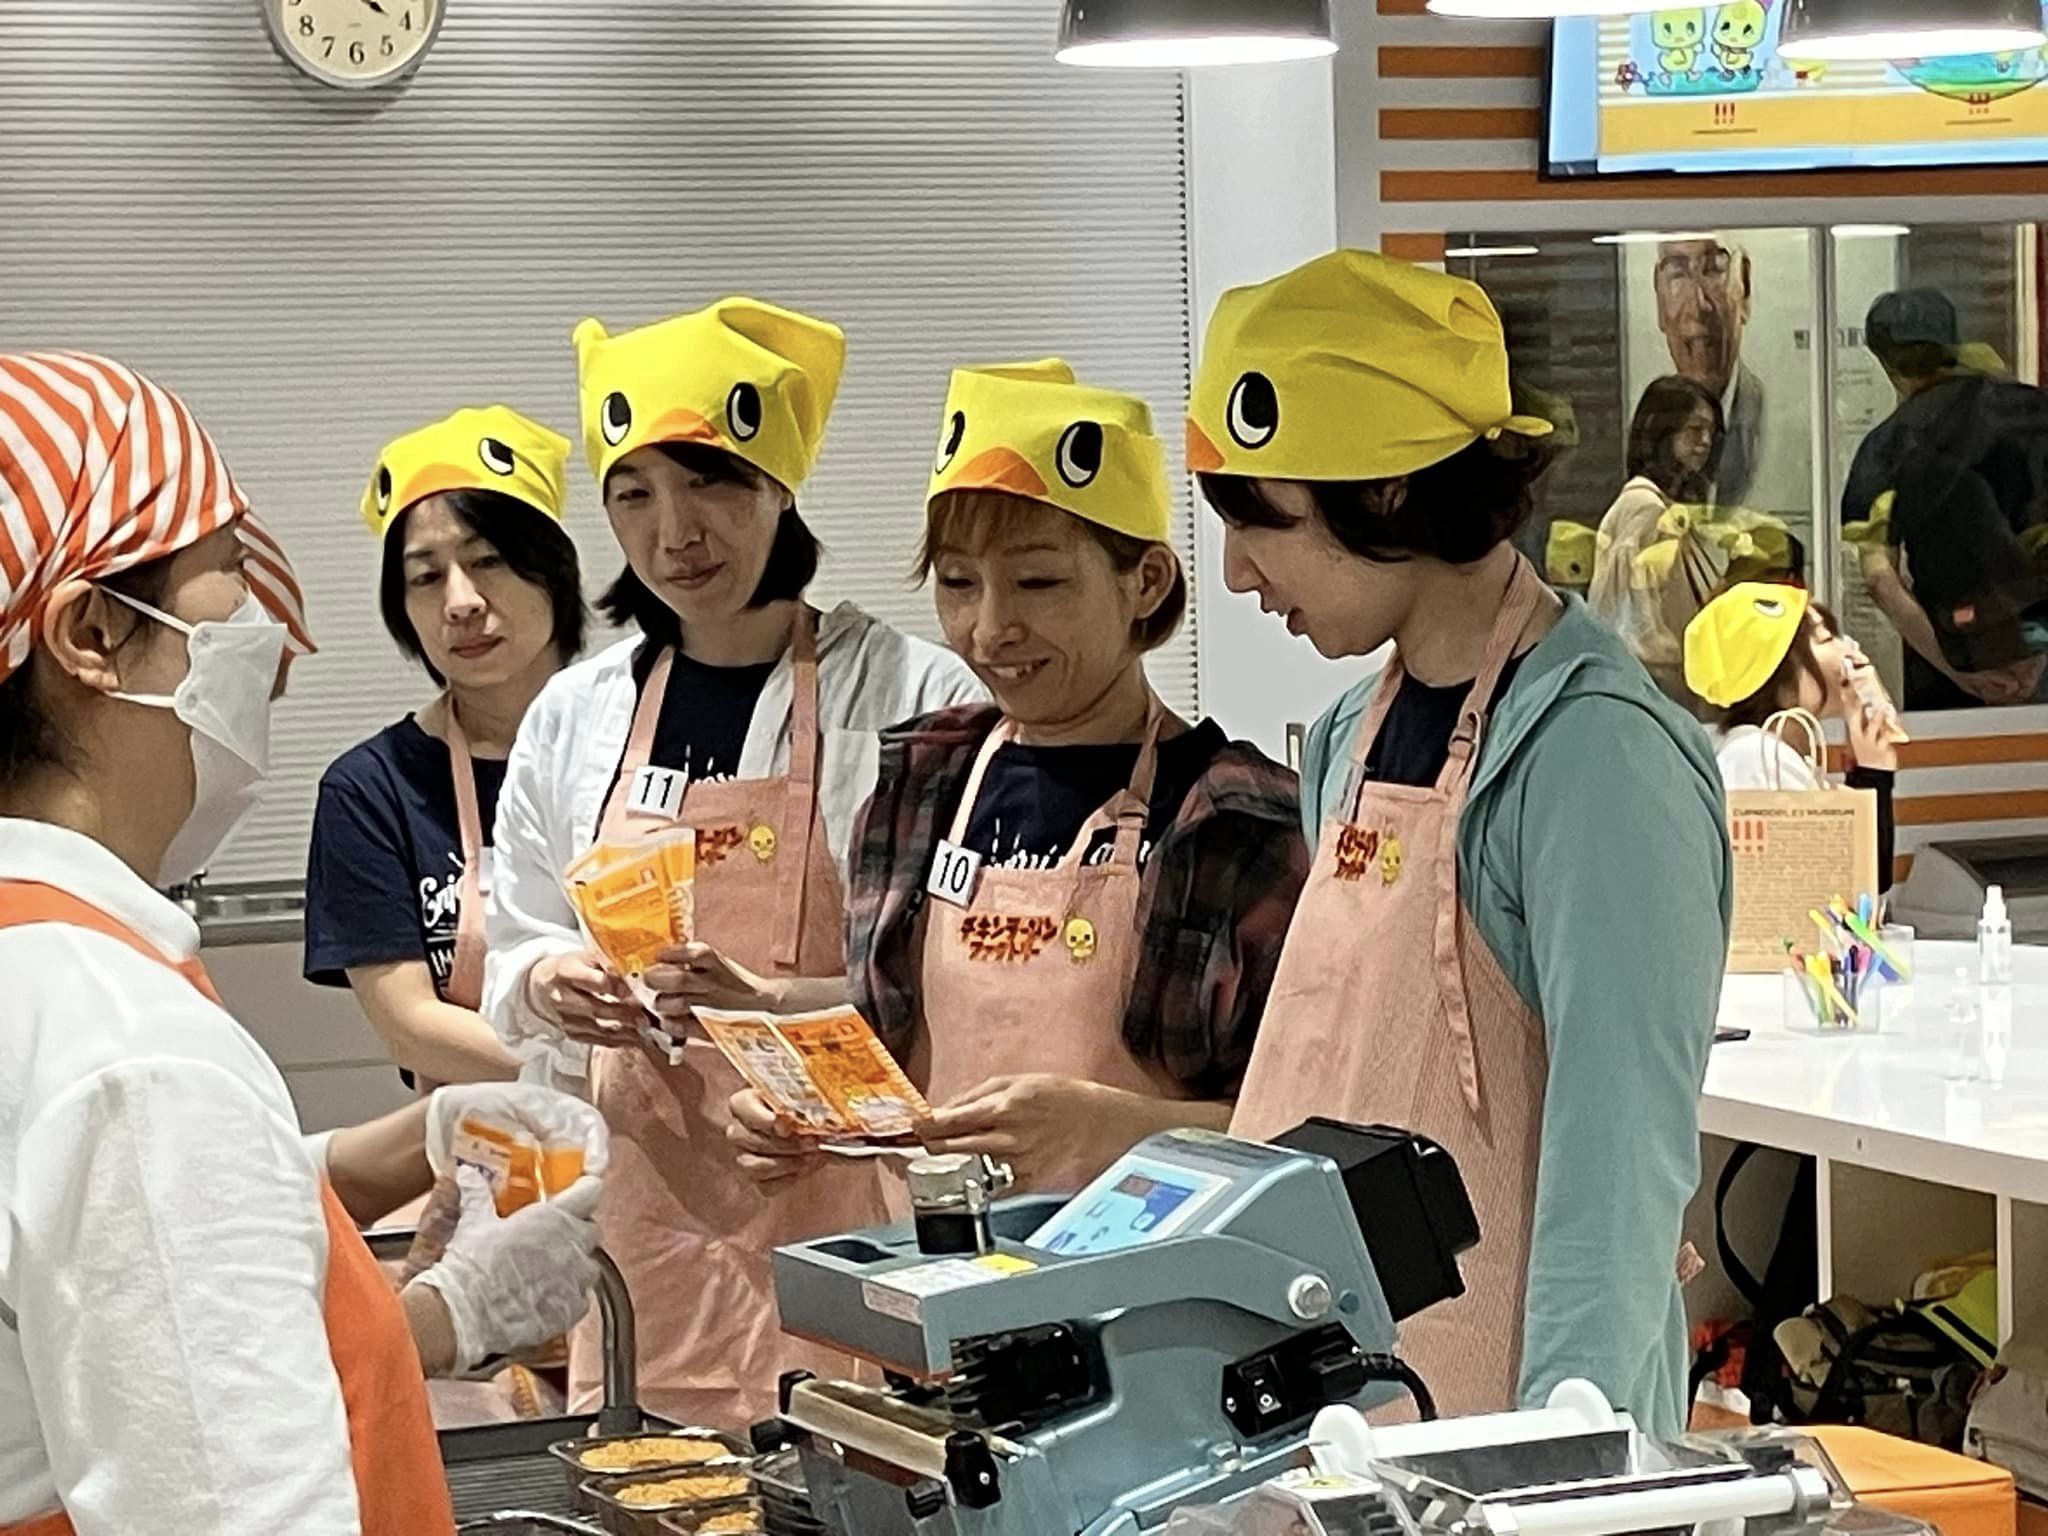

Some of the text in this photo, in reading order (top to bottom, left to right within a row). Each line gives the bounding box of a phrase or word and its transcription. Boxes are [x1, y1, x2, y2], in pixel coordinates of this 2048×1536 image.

[299, 15, 315, 36] 8
[399, 10, 411, 31] 4
[321, 36, 335, 58] 7
[349, 41, 365, 64] 6
[380, 35, 394, 56] 5
[641, 771, 674, 809] 11
[938, 851, 970, 893] 10
